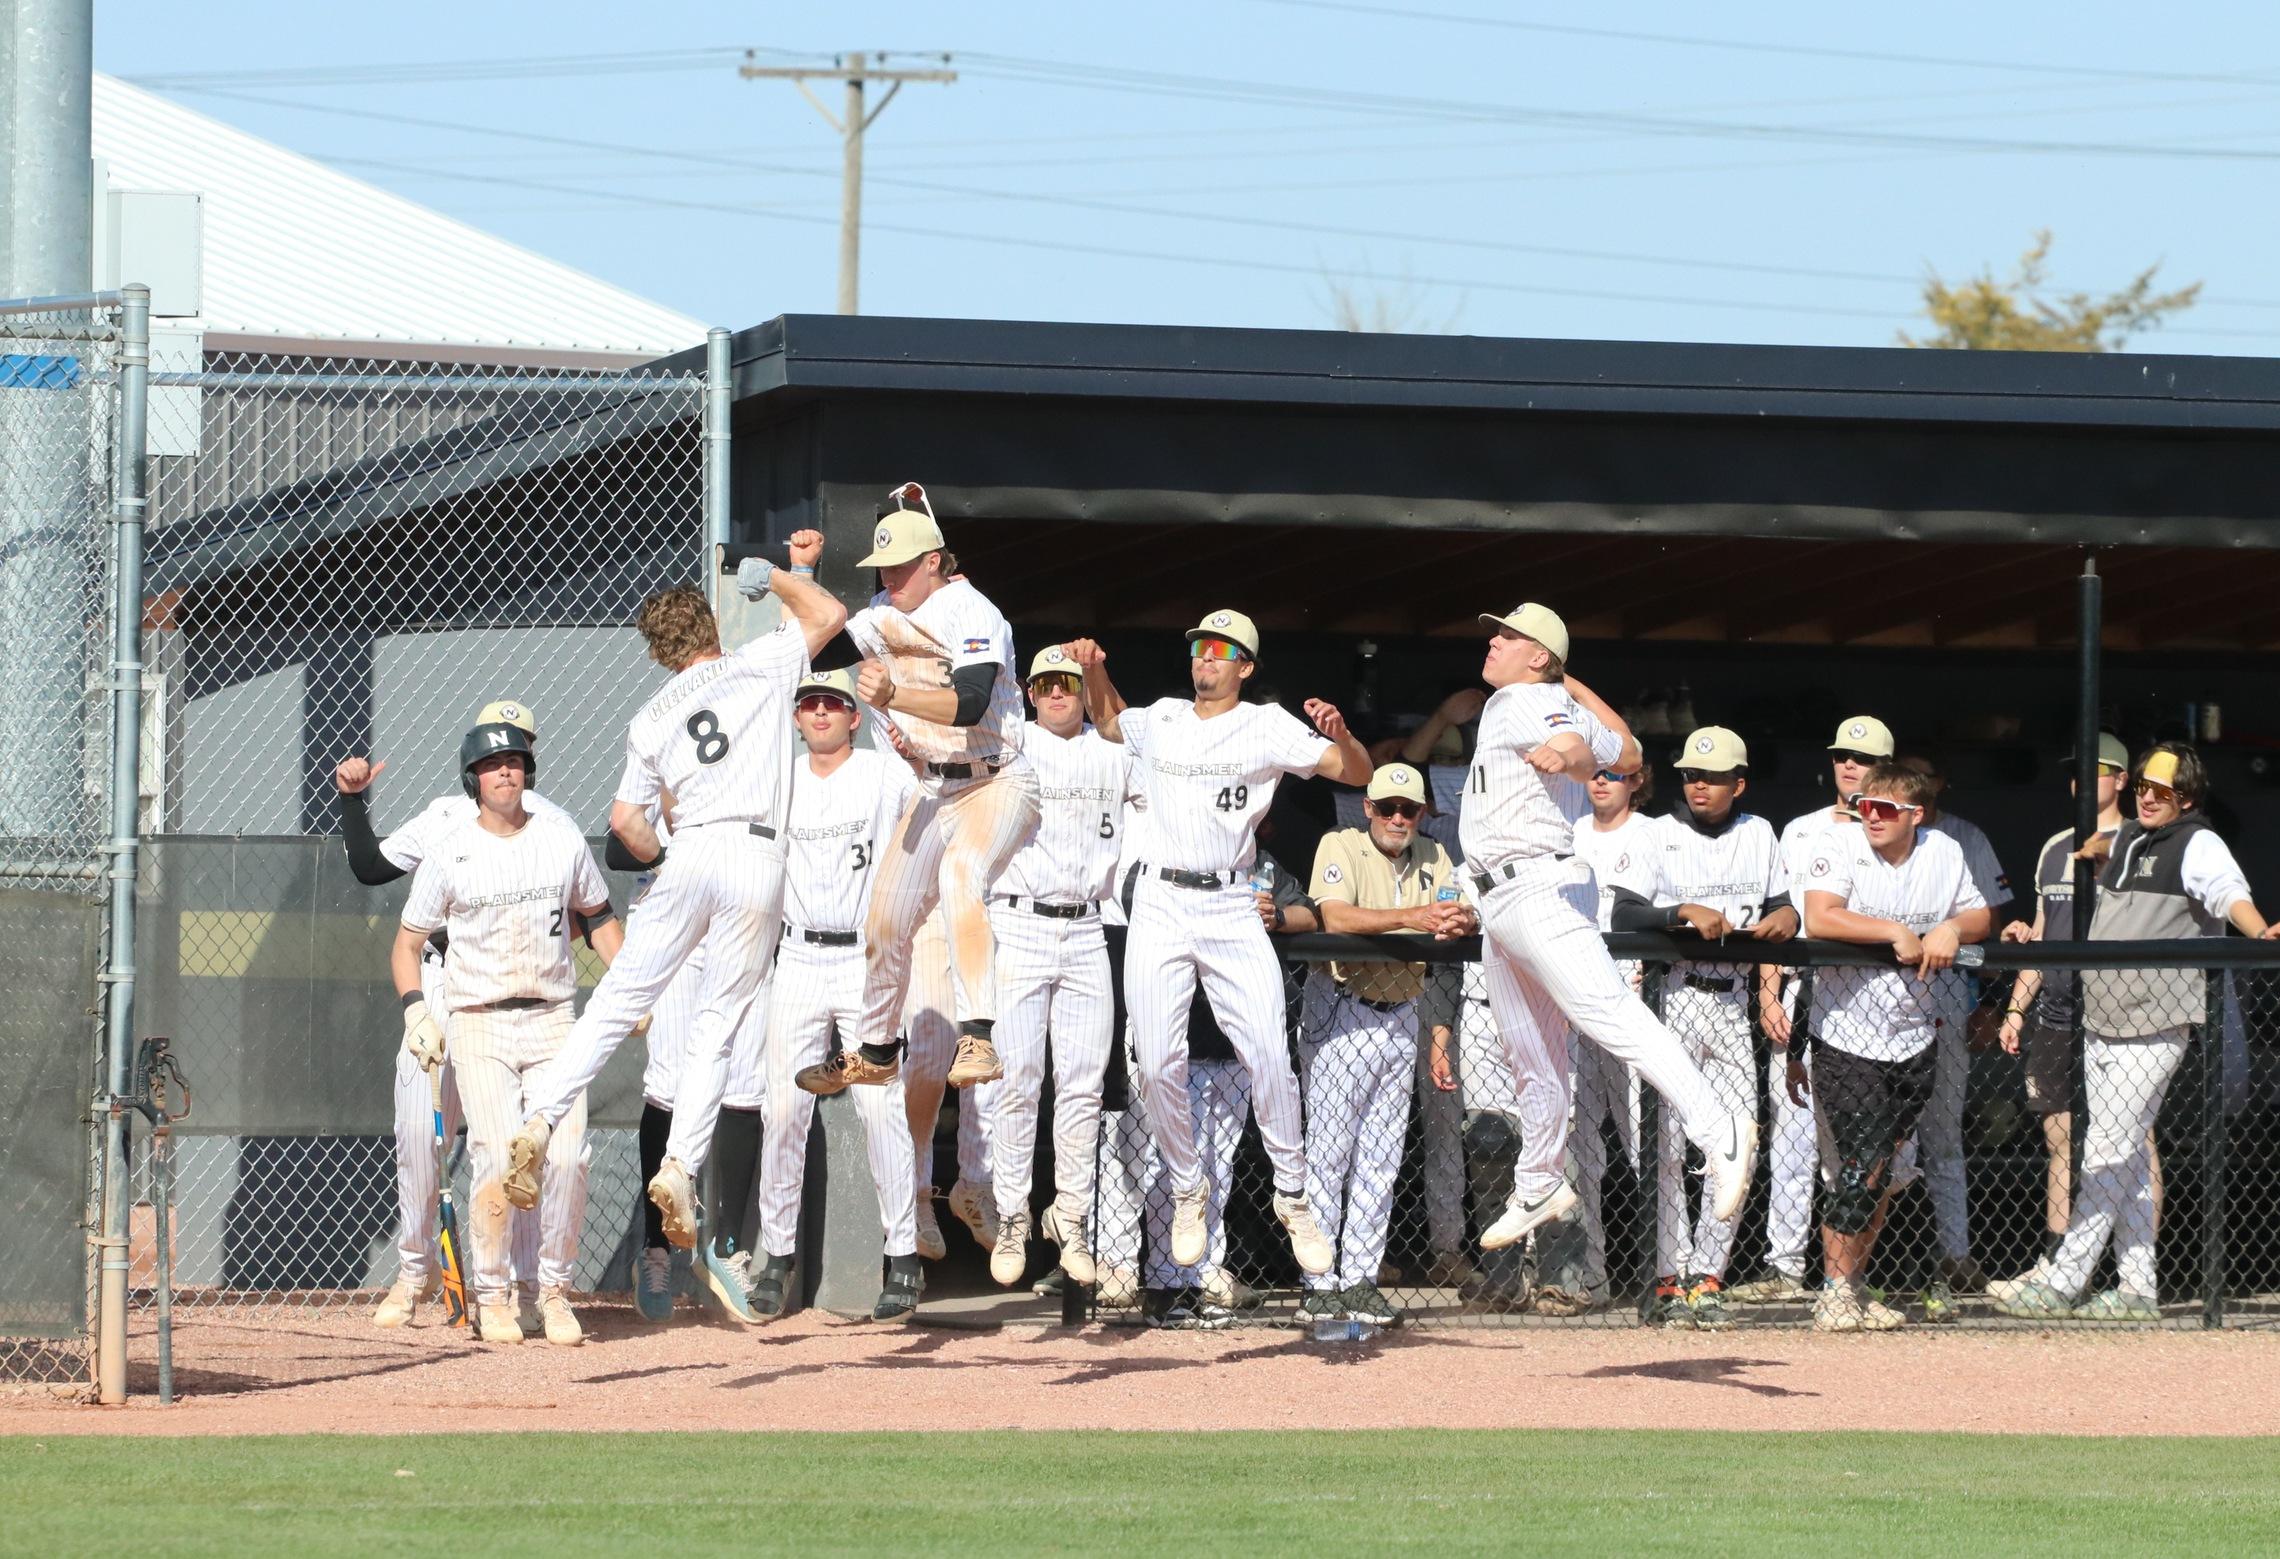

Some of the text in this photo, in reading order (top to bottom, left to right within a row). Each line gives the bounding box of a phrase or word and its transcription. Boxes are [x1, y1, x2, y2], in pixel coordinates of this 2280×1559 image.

[646, 660, 729, 722] CLELLAND
[487, 730, 510, 748] N
[686, 708, 730, 766] 8
[1472, 765, 1487, 794] 11
[1215, 785, 1248, 812] 49
[1099, 812, 1115, 839] 5
[851, 839, 873, 871] 31
[2135, 856, 2158, 877] N
[470, 885, 565, 908] PLAINSMEN
[1675, 882, 1763, 898] PLAINSMEN
